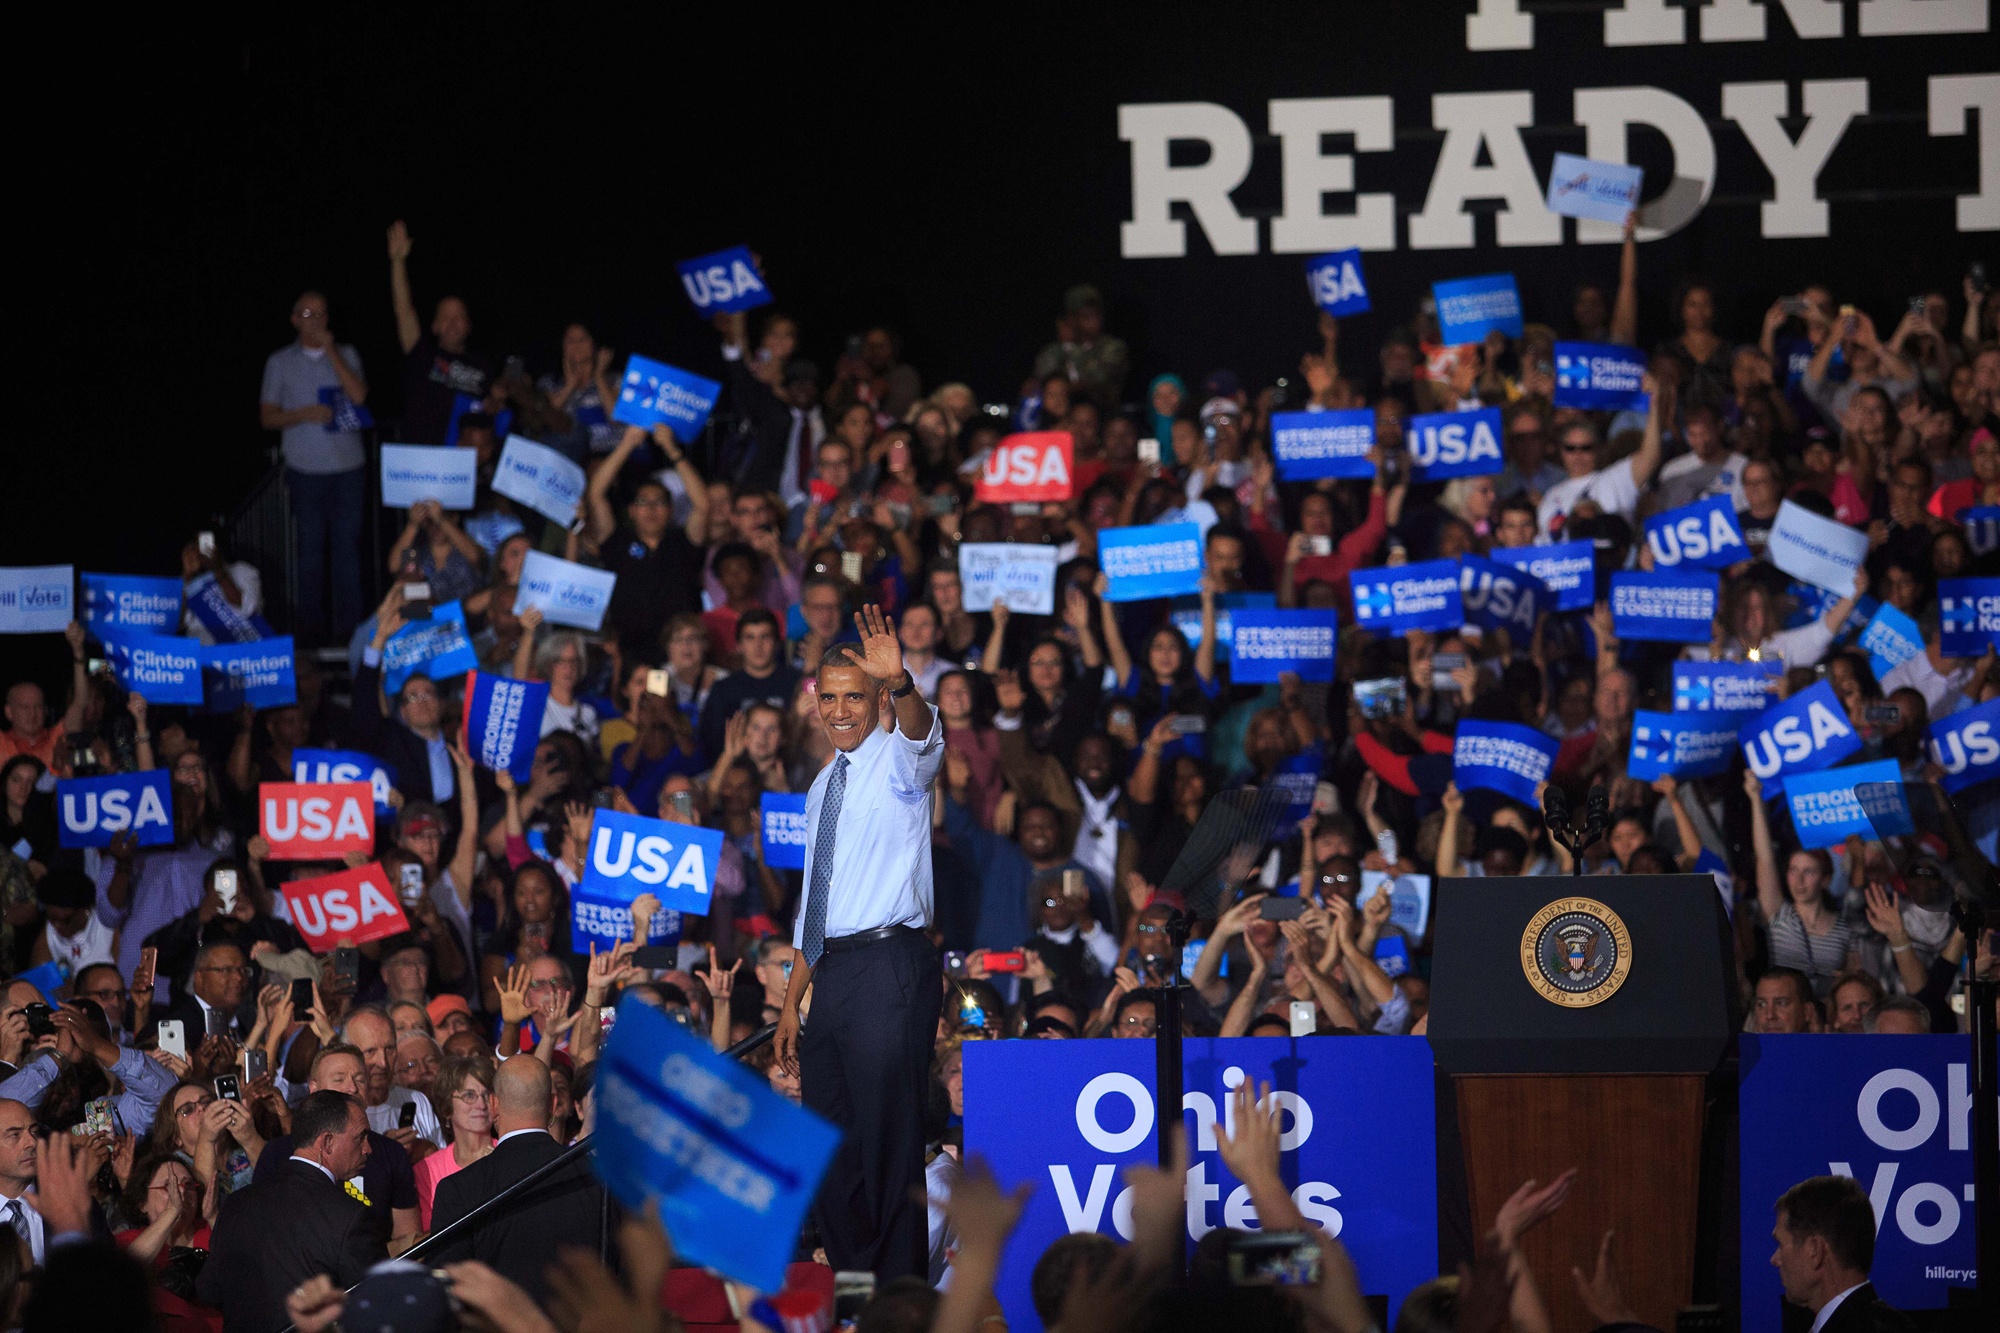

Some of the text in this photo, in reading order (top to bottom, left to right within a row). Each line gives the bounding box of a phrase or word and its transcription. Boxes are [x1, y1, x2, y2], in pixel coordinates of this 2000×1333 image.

[1118, 79, 1869, 259] READY
[682, 258, 765, 309] USA
[1590, 374, 1641, 391] Kaine
[654, 396, 697, 423] Kaine
[658, 381, 713, 413] Clinton
[1274, 425, 1371, 445] STRONGER
[1408, 420, 1500, 468] USA
[1276, 442, 1373, 460] TOGETHER
[984, 443, 1070, 487] USA
[1646, 508, 1742, 567] USA
[1103, 538, 1199, 564] STRONGER
[1103, 555, 1200, 579] TOGETHER
[1390, 573, 1458, 599] Clinton
[1460, 565, 1537, 630] USA
[1612, 584, 1715, 602] STRONGER
[118, 592, 179, 612] Clinton
[1393, 592, 1447, 615] Kaine
[1613, 600, 1715, 620] TOGETHER
[118, 610, 167, 627] Kaine
[1235, 626, 1334, 644] STRONGER
[132, 648, 197, 671] Clinton
[1235, 643, 1334, 660] TOGETHER
[133, 665, 185, 685] Kaine
[227, 654, 291, 676] Clinton
[1713, 694, 1767, 712] Kaine
[1673, 729, 1738, 749] Clinton
[1744, 699, 1850, 779] USA
[1456, 735, 1551, 772] STRONGER
[1673, 745, 1724, 764] Kaine
[1454, 752, 1546, 783] TOGETHER
[61, 785, 170, 833] USA
[1792, 779, 1901, 814] STRONGER
[264, 797, 371, 843] USA
[1798, 797, 1902, 828] TOGETHER
[592, 826, 709, 895] USA
[290, 881, 398, 938] USA
[1525, 901, 1629, 1003] SEAL OF THE PRESIDENT OF THE UNITED STATES
